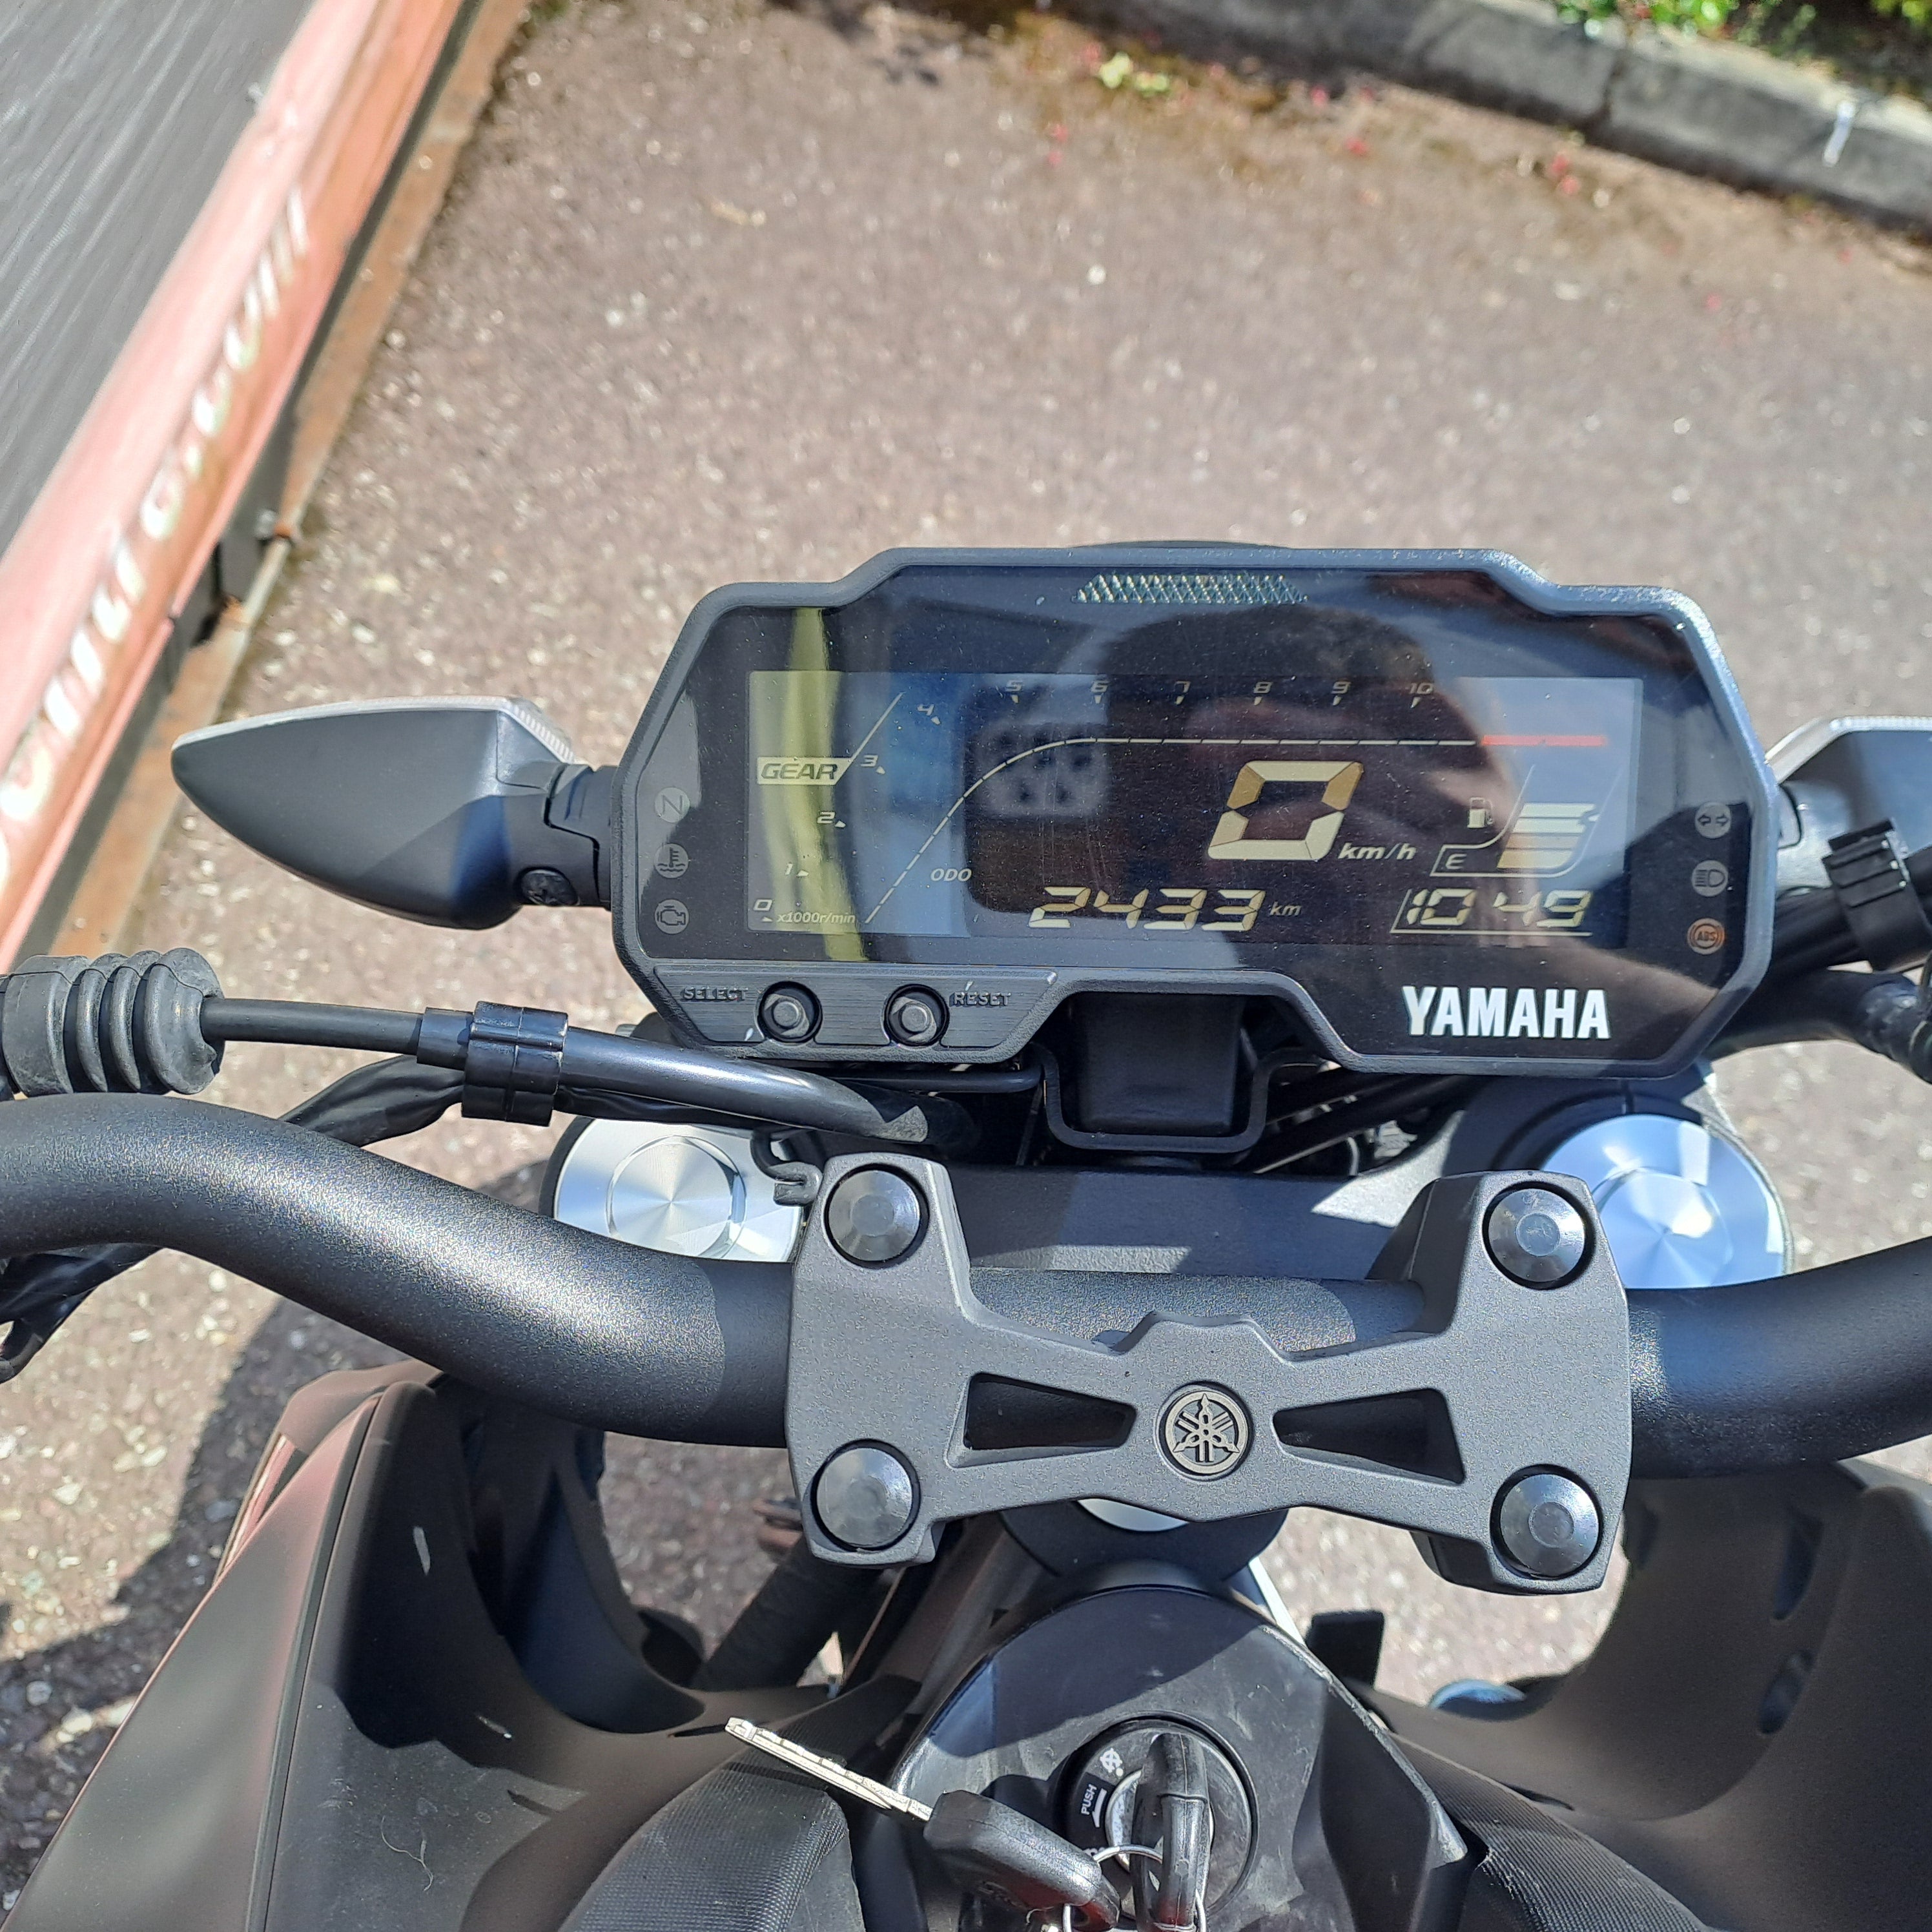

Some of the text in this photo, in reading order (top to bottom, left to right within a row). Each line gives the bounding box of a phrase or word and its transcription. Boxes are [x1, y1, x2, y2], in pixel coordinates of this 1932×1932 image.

[1005, 680, 1023, 692] 5
[1090, 681, 1109, 692] 6
[1175, 681, 1191, 693] 7
[1253, 681, 1273, 694] 8
[1331, 681, 1351, 694] 9
[1408, 683, 1434, 694] 10
[917, 703, 934, 716] 4
[861, 755, 878, 767] 3
[761, 763, 838, 780] GEAR
[661, 795, 683, 815] N
[1208, 761, 1417, 861] 0 km/h
[817, 811, 836, 824] 2
[1445, 854, 1468, 869] E
[785, 862, 793, 876] 1
[930, 868, 971, 881] ODO
[753, 899, 774, 912] 0
[1028, 886, 1301, 931] 2433 km
[1697, 931, 1716, 941] ABS
[681, 987, 748, 1002] SELECT
[949, 991, 1011, 1007] RESET
[1401, 985, 1611, 1039] YAMAHA
[1081, 1783, 1097, 1815] PUSH
